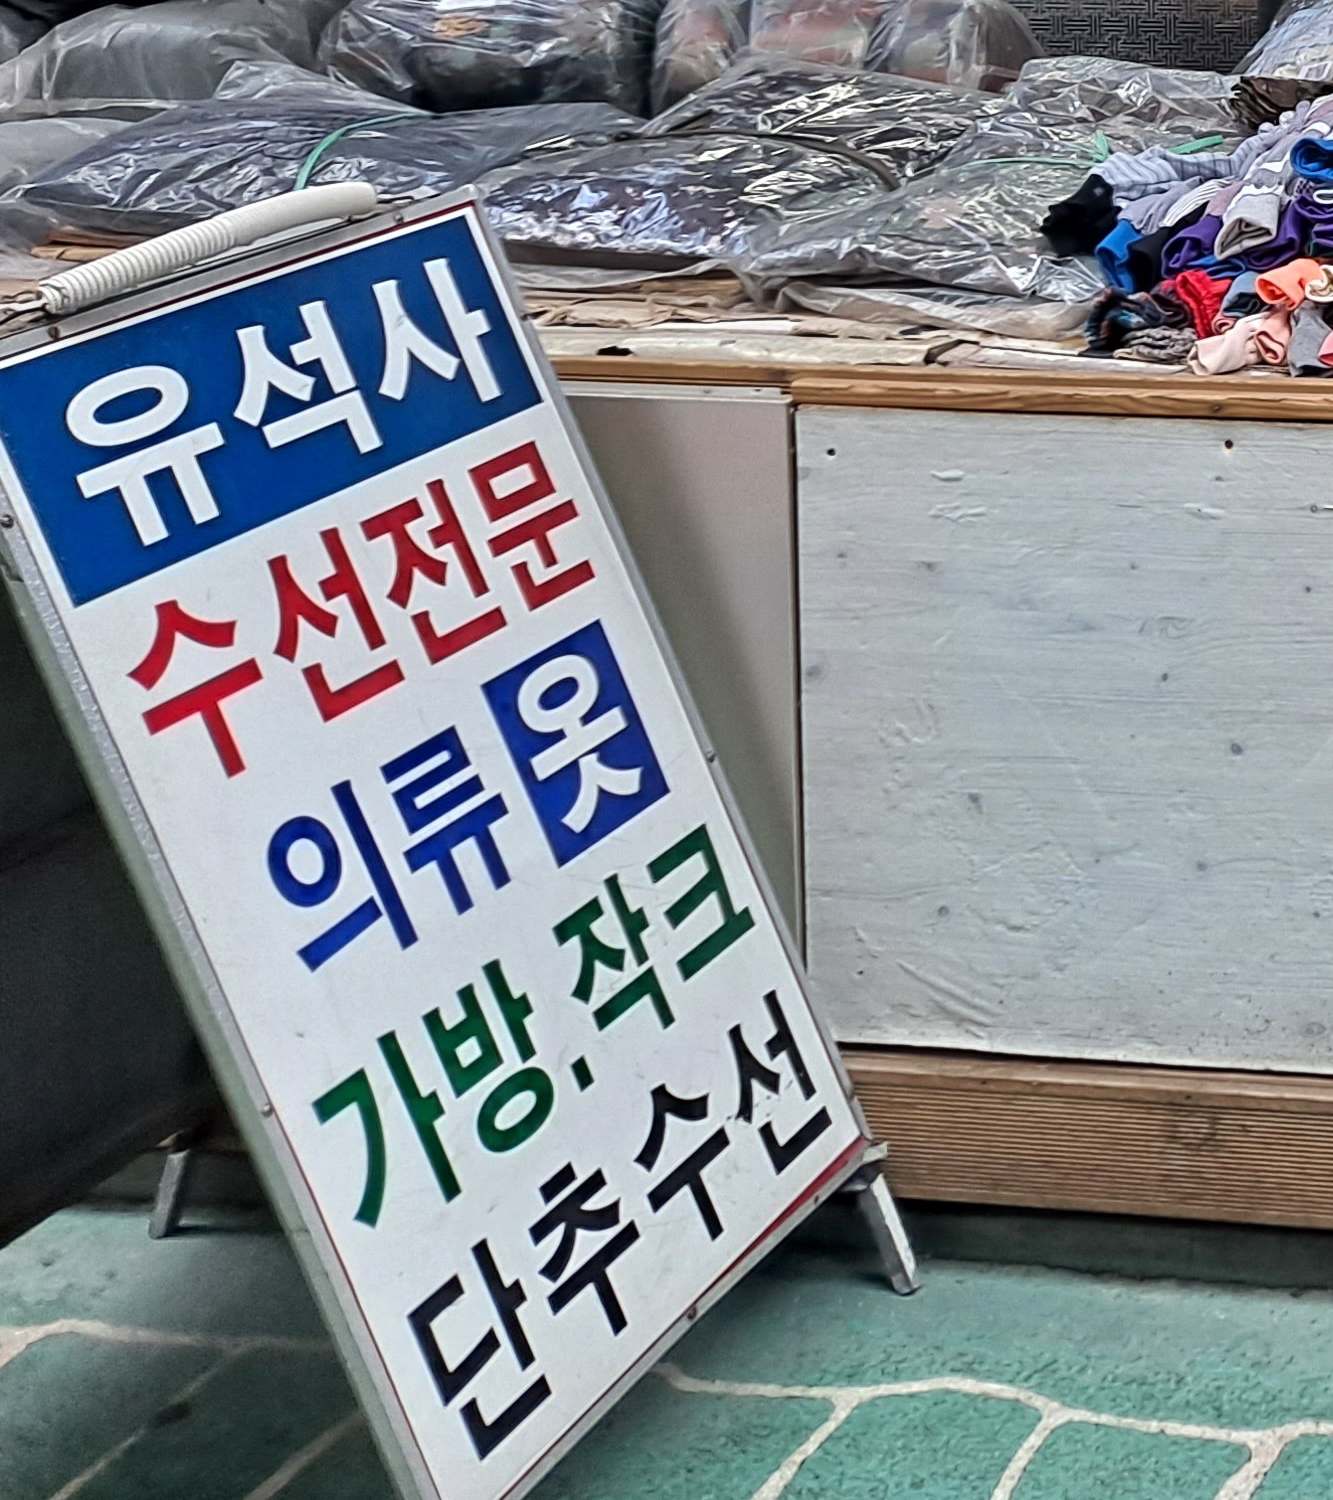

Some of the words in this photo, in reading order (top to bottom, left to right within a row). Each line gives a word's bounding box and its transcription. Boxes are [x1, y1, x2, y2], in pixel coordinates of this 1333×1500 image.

[64, 256, 502, 549] 유석사
[127, 439, 597, 779] 수선전문
[266, 724, 512, 973] 의류
[516, 654, 643, 835] 옷
[311, 822, 756, 1229] 가방.작크
[407, 989, 832, 1462] 단추수선
